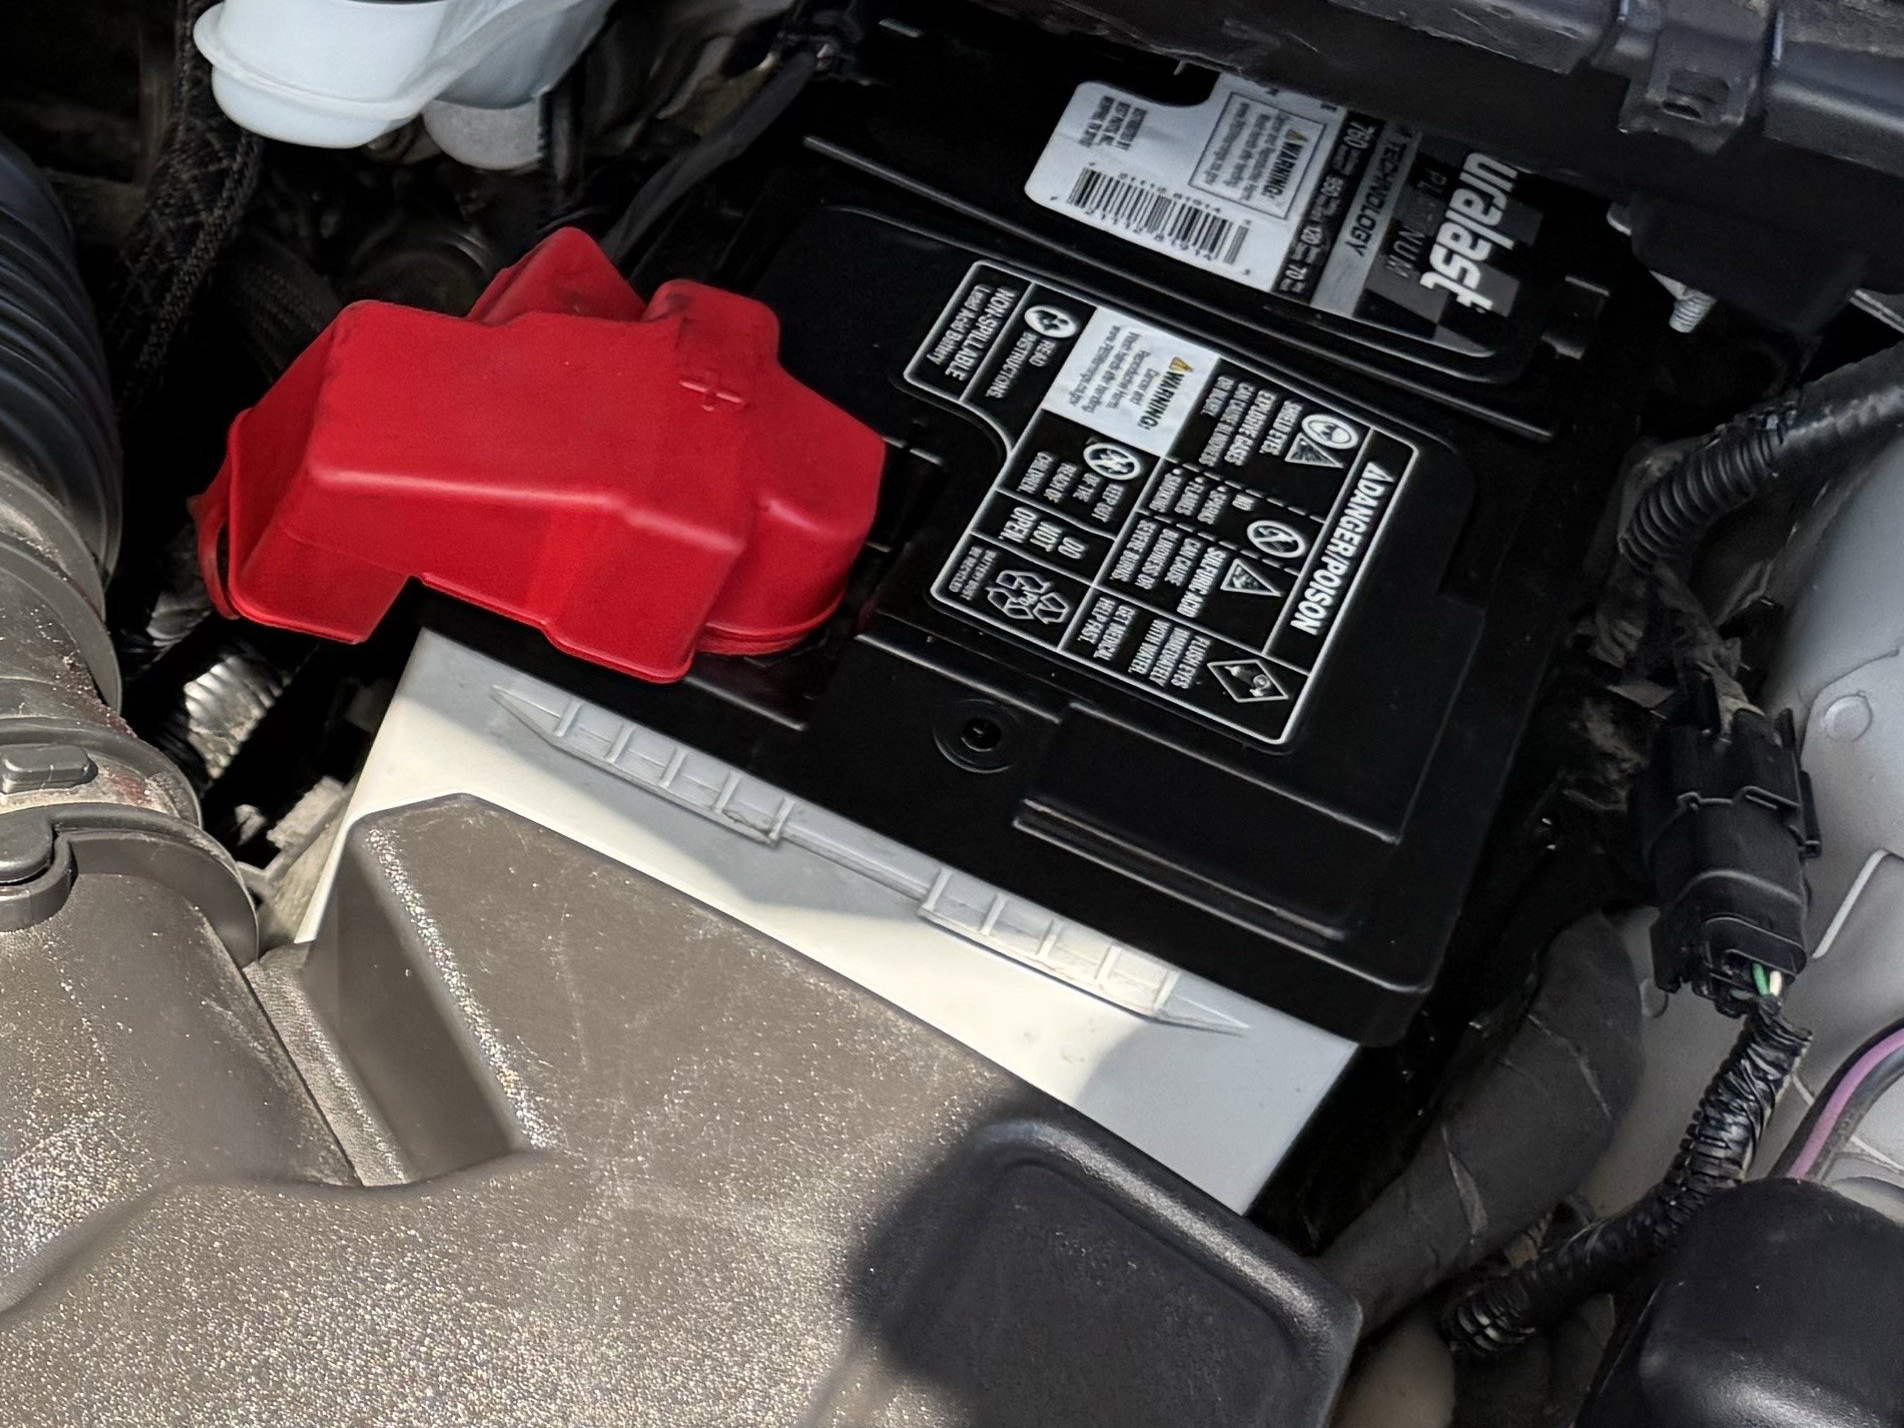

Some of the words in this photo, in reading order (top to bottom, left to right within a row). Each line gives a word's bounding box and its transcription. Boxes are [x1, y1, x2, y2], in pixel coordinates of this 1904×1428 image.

[1344, 139, 1407, 257] TECHNOLOGY
[1418, 151, 1520, 310] uralast
[944, 286, 1015, 382] NON-SPILLABLE
[949, 307, 975, 333] Acid
[924, 328, 962, 365] Battery
[1027, 337, 1054, 368] READ
[984, 330, 1037, 402] INSTRUCTIONS.
[1136, 368, 1184, 432] WARNING:
[997, 505, 1037, 548] OPEN.
[1028, 520, 1062, 552] NOT
[1056, 534, 1087, 561] DO
[1178, 536, 1201, 559] CAN
[1289, 475, 1386, 636] DANGER/POISON
[1134, 572, 1155, 590] OR
[1163, 554, 1192, 587] CAUSE
[1187, 544, 1226, 596] SULFURIC
[1089, 595, 1116, 623] HELP
[1112, 603, 1136, 626] GET
[1175, 590, 1203, 619] ACID
[1077, 618, 1104, 646] FAST.
[1143, 617, 1169, 647] WITH
[1181, 633, 1211, 666] FLUSH
[1170, 662, 1196, 690] EYES
